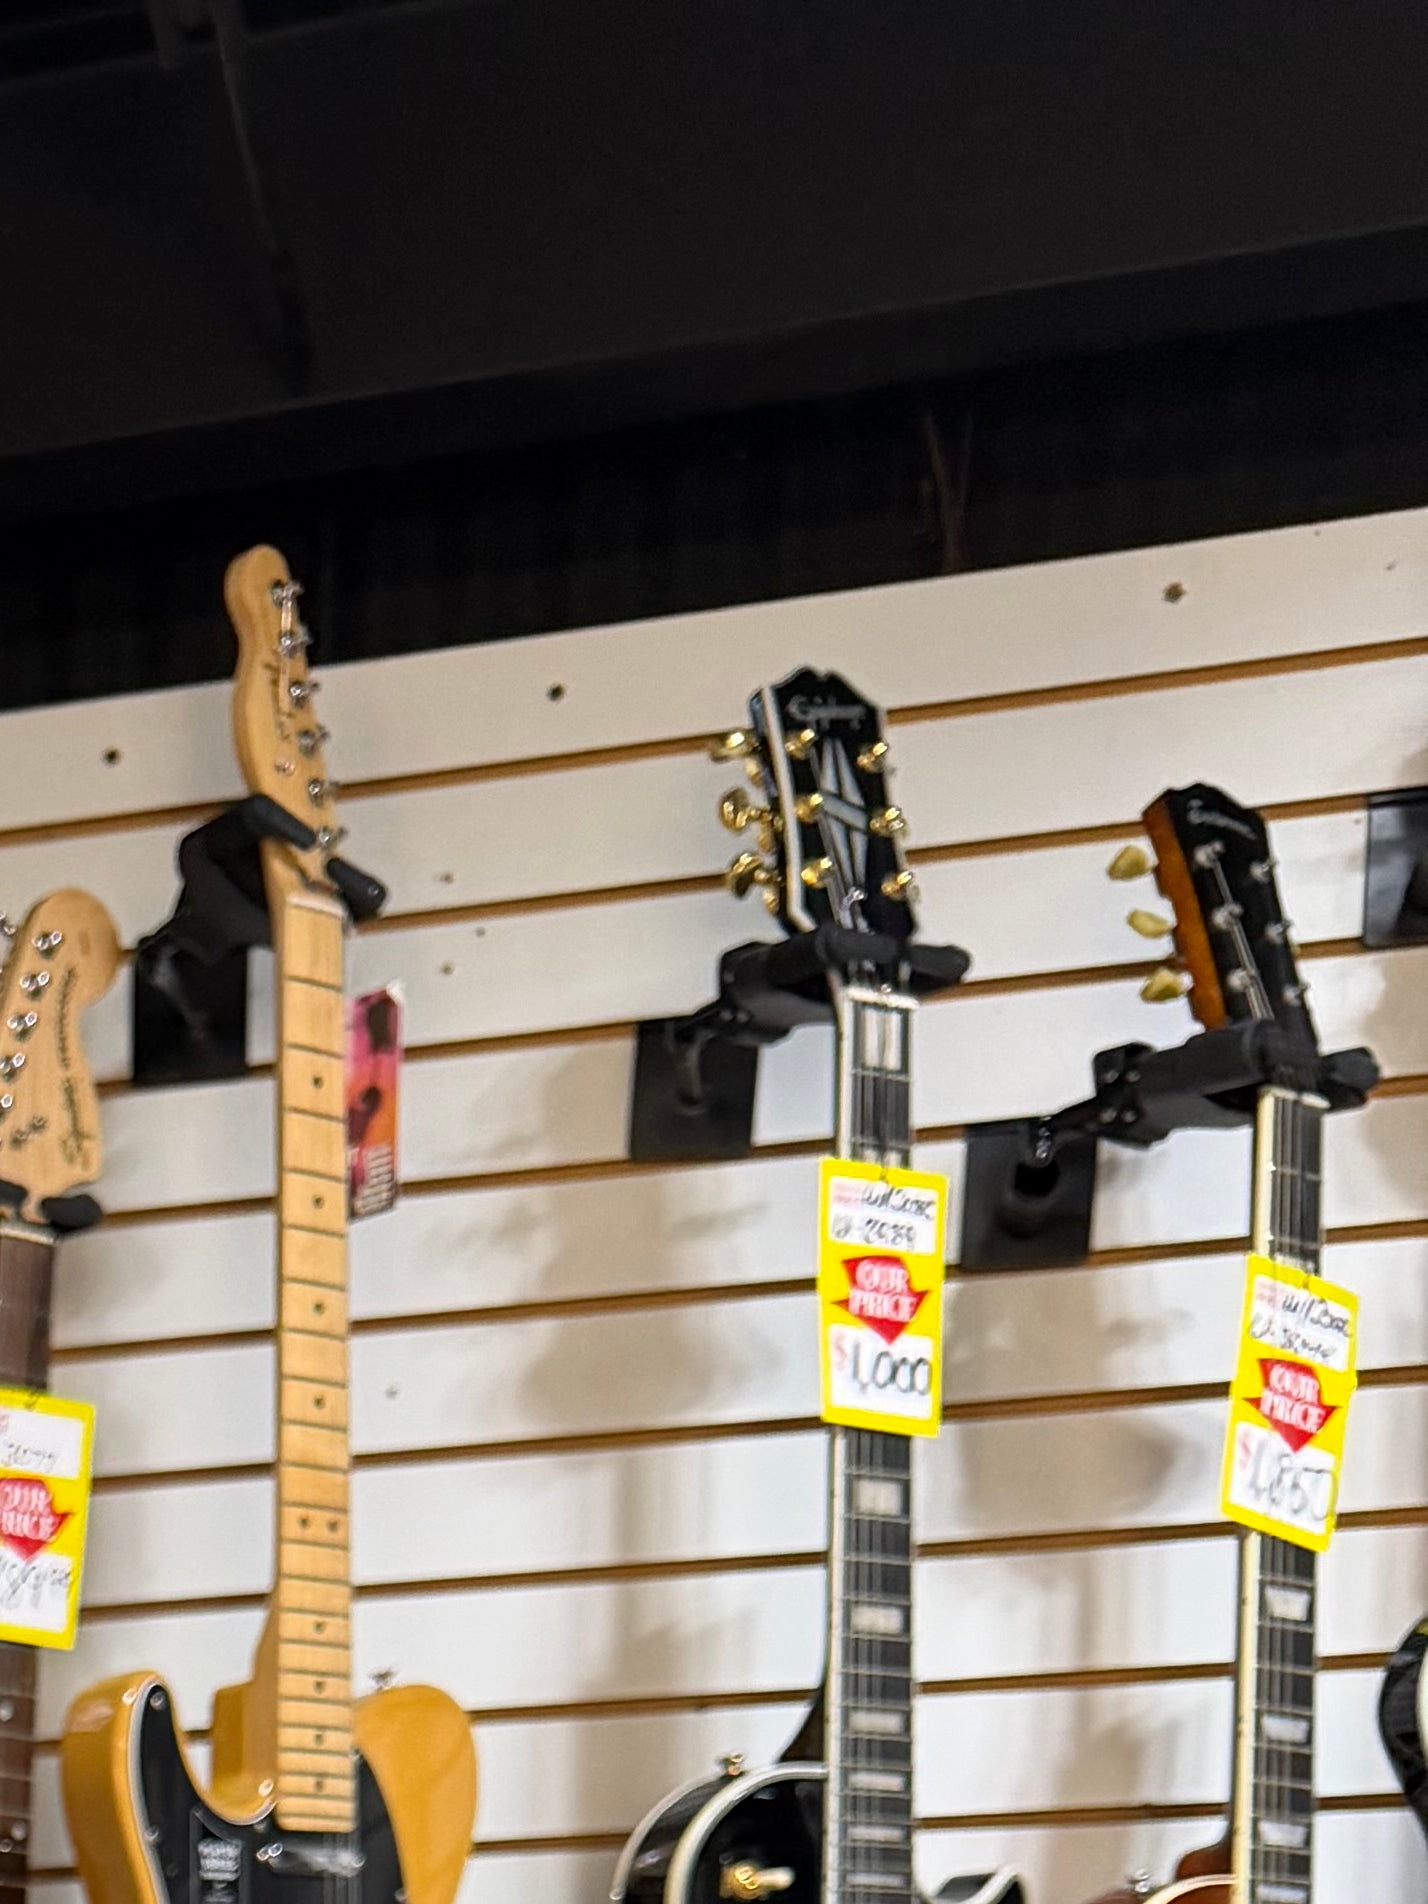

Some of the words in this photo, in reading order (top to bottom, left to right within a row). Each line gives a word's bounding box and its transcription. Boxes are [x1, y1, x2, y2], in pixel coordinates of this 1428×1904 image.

[855, 1256, 911, 1293] OUR
[847, 1287, 919, 1323] PRICE
[1268, 1363, 1320, 1405] OUR
[1259, 1389, 1327, 1434] PRICE
